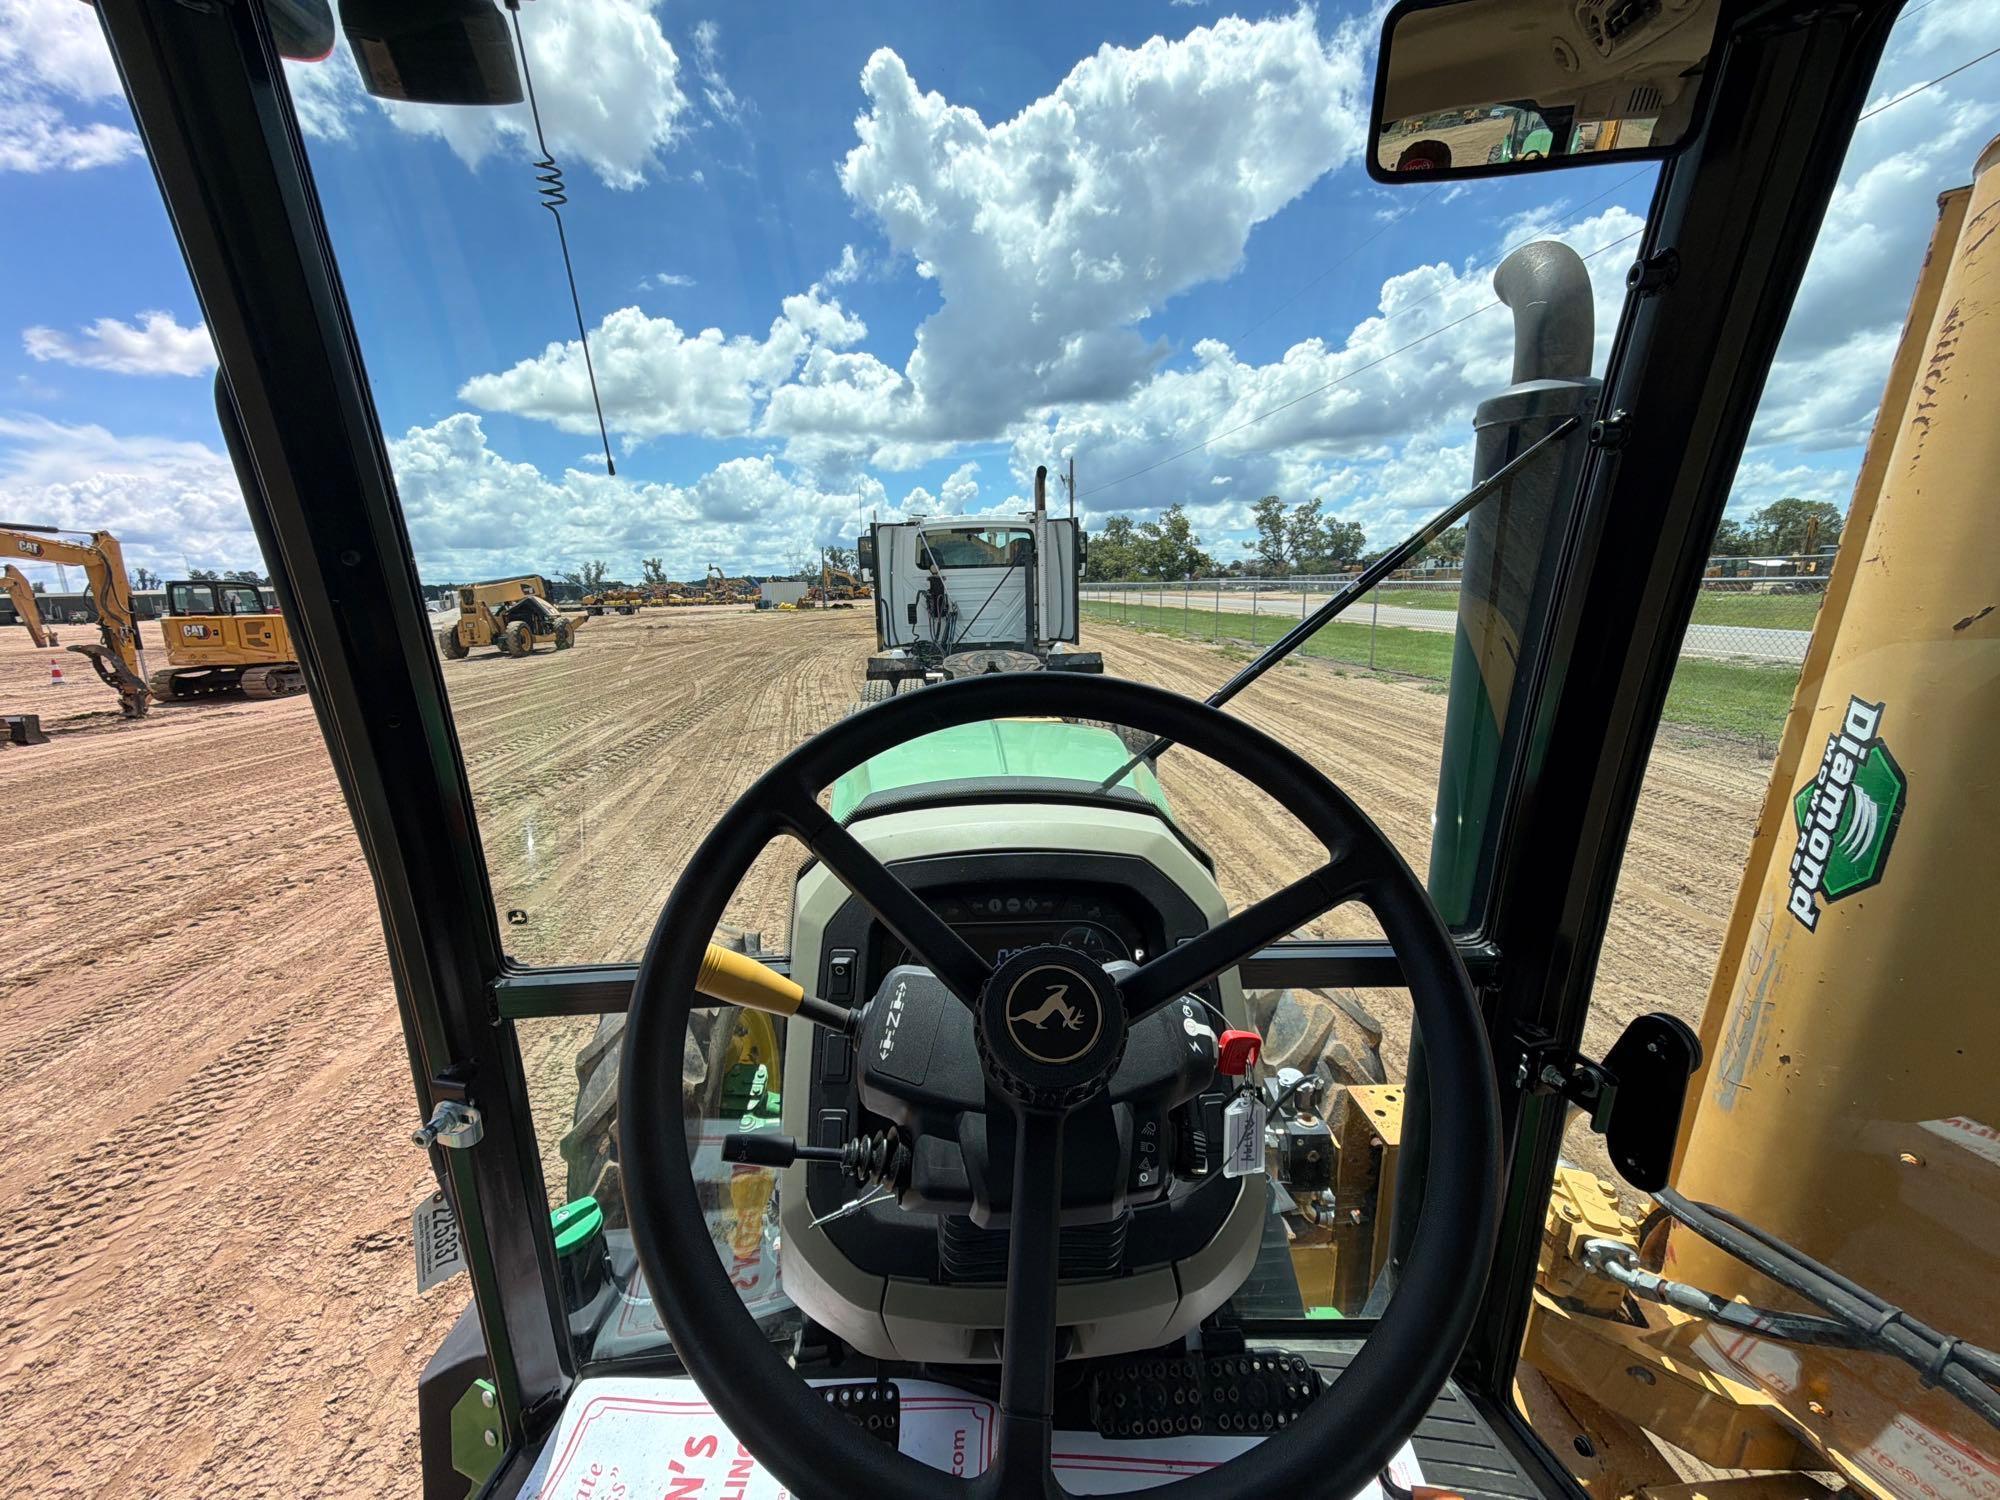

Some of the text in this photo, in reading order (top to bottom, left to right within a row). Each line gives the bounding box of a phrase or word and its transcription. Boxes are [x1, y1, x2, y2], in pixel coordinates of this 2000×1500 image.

[18, 540, 39, 554] CAT
[183, 625, 204, 637] CAT
[1791, 739, 1836, 872] MOWERS
[1790, 700, 1879, 927] Diamond
[1134, 949, 1144, 960] P
[886, 1011, 901, 1028] N
